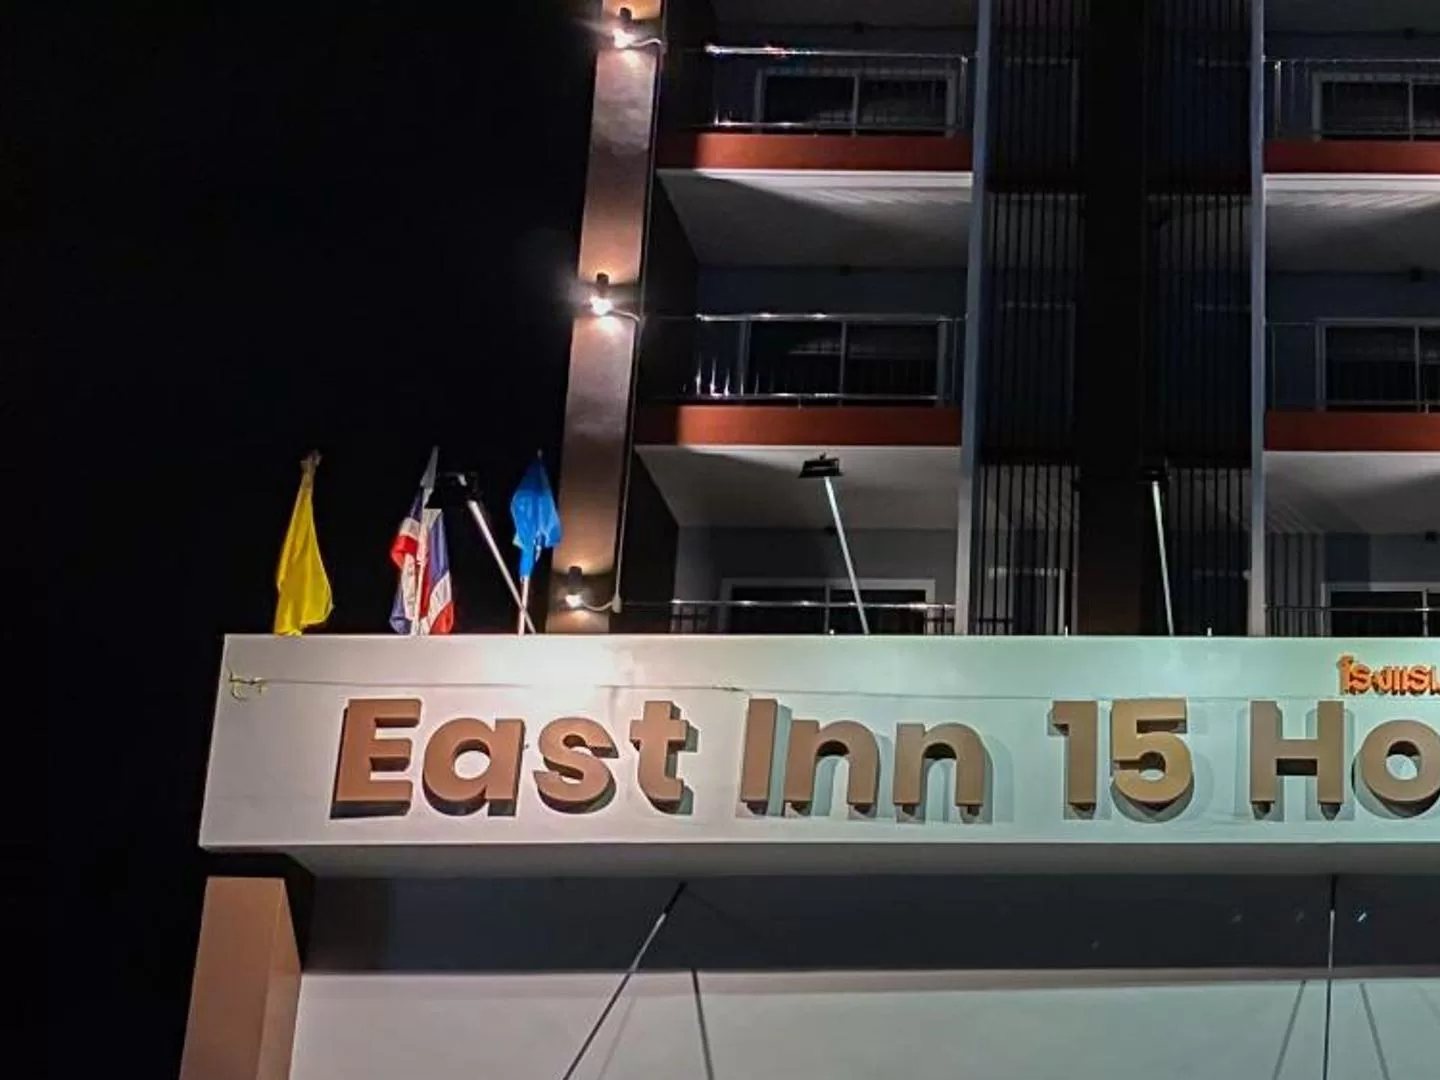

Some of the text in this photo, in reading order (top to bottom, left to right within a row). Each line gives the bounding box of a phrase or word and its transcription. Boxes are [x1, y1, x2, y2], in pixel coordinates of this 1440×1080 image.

[331, 697, 694, 817] East
[741, 698, 988, 821] Inn
[1052, 698, 1194, 818] 15
